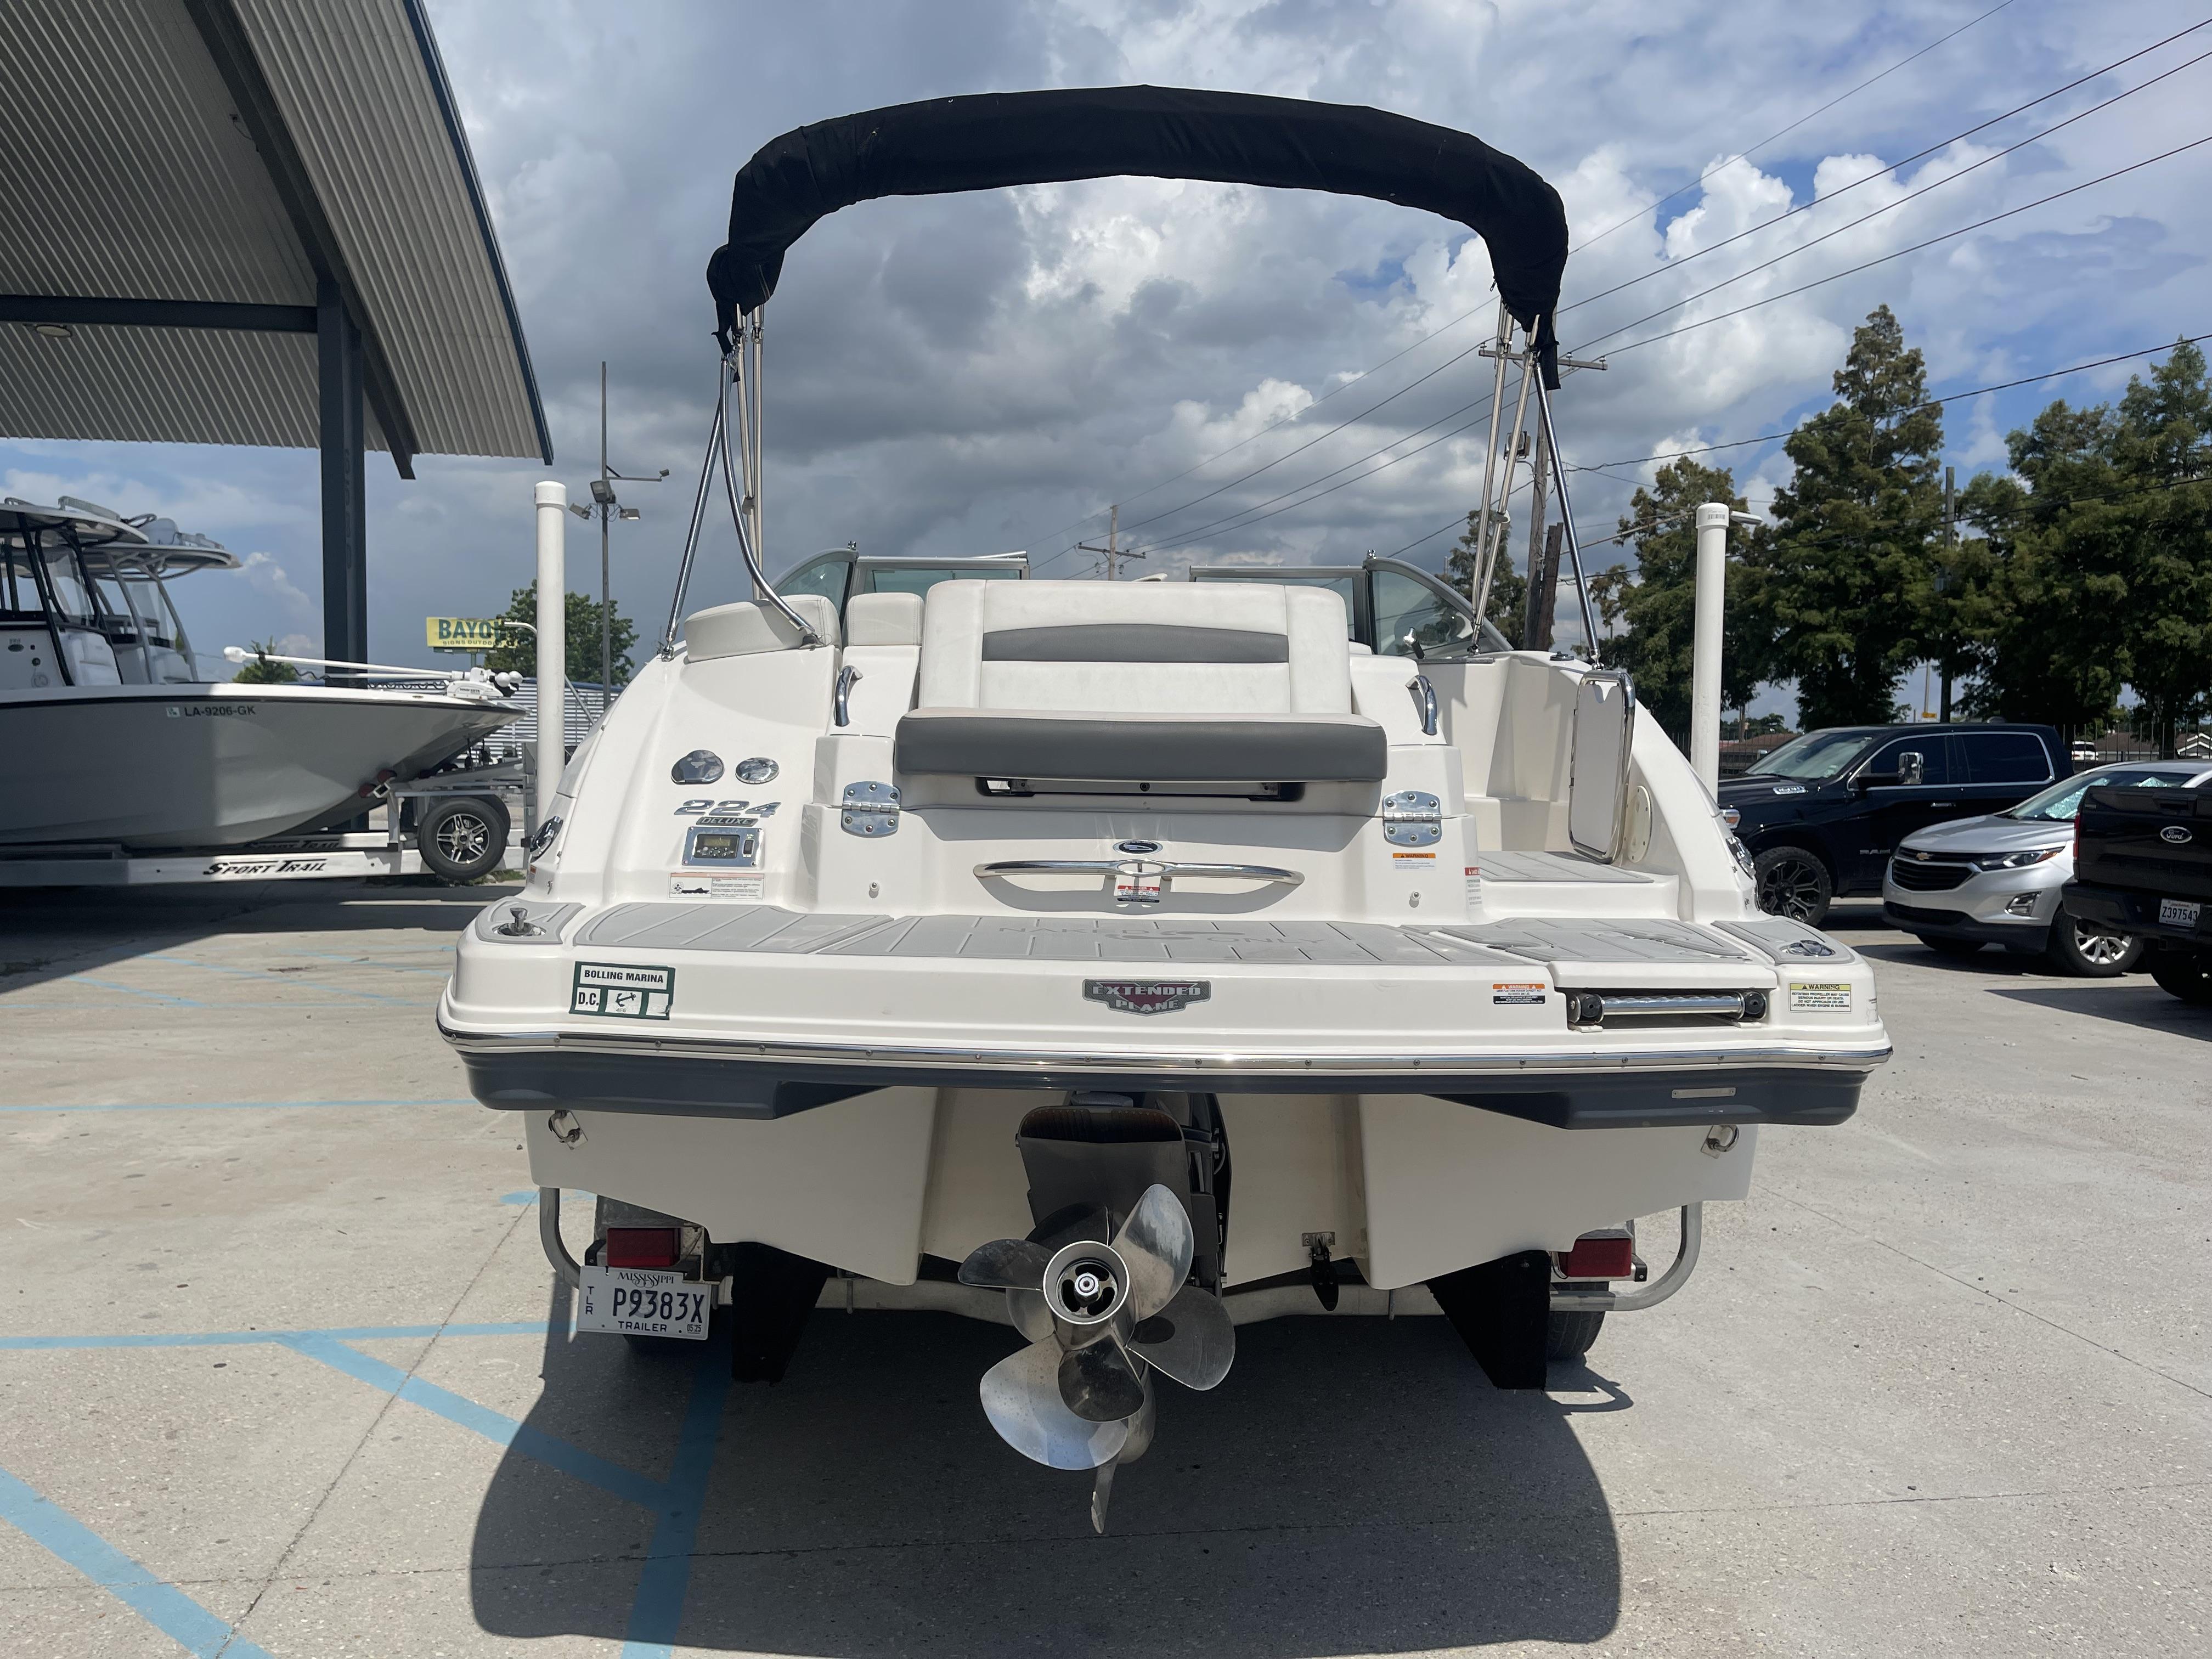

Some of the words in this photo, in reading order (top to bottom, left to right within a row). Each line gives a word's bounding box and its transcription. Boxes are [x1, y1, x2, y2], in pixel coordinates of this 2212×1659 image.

[184, 705, 256, 717] LA-9206-GK
[674, 799, 782, 818] 224
[701, 817, 752, 825] DELUXE
[2166, 828, 2184, 840] Ford
[203, 861, 278, 876] SPORT
[276, 859, 327, 873] TRAIL
[584, 970, 623, 980] BOLLING
[625, 973, 664, 983] MARINA
[1092, 986, 1201, 995] EXTENDED
[578, 991, 600, 1006] D.C.
[1115, 999, 1179, 1013] PLANE
[617, 1272, 674, 1289] MISSISSIPPI
[585, 1285, 595, 1315] TLR
[612, 1288, 705, 1324] P9383X
[618, 1321, 668, 1333] TRAILER
